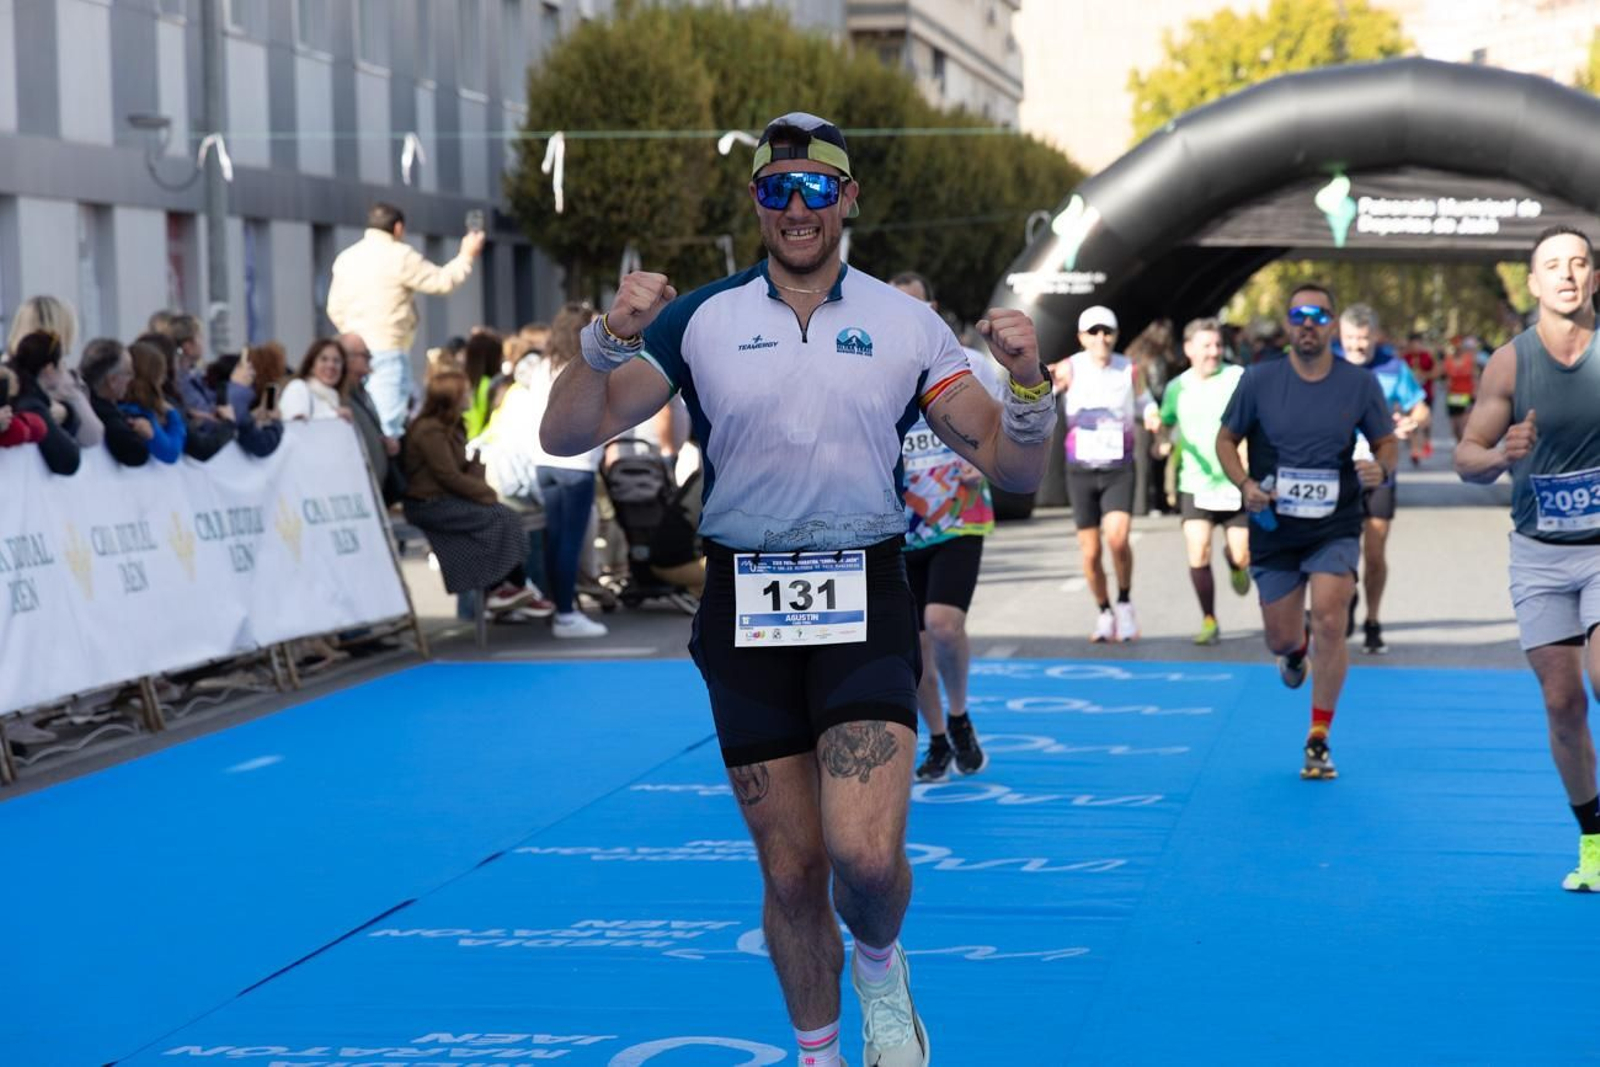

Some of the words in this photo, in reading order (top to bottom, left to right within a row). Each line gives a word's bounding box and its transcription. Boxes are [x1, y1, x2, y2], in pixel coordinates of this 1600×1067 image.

[1517, 199, 1541, 217] de
[738, 341, 778, 351] TEAMERGY
[1288, 483, 1328, 500] 429
[763, 579, 836, 612] 131
[411, 1032, 618, 1045] JAÉN
[160, 1045, 571, 1059] MARATÓN
